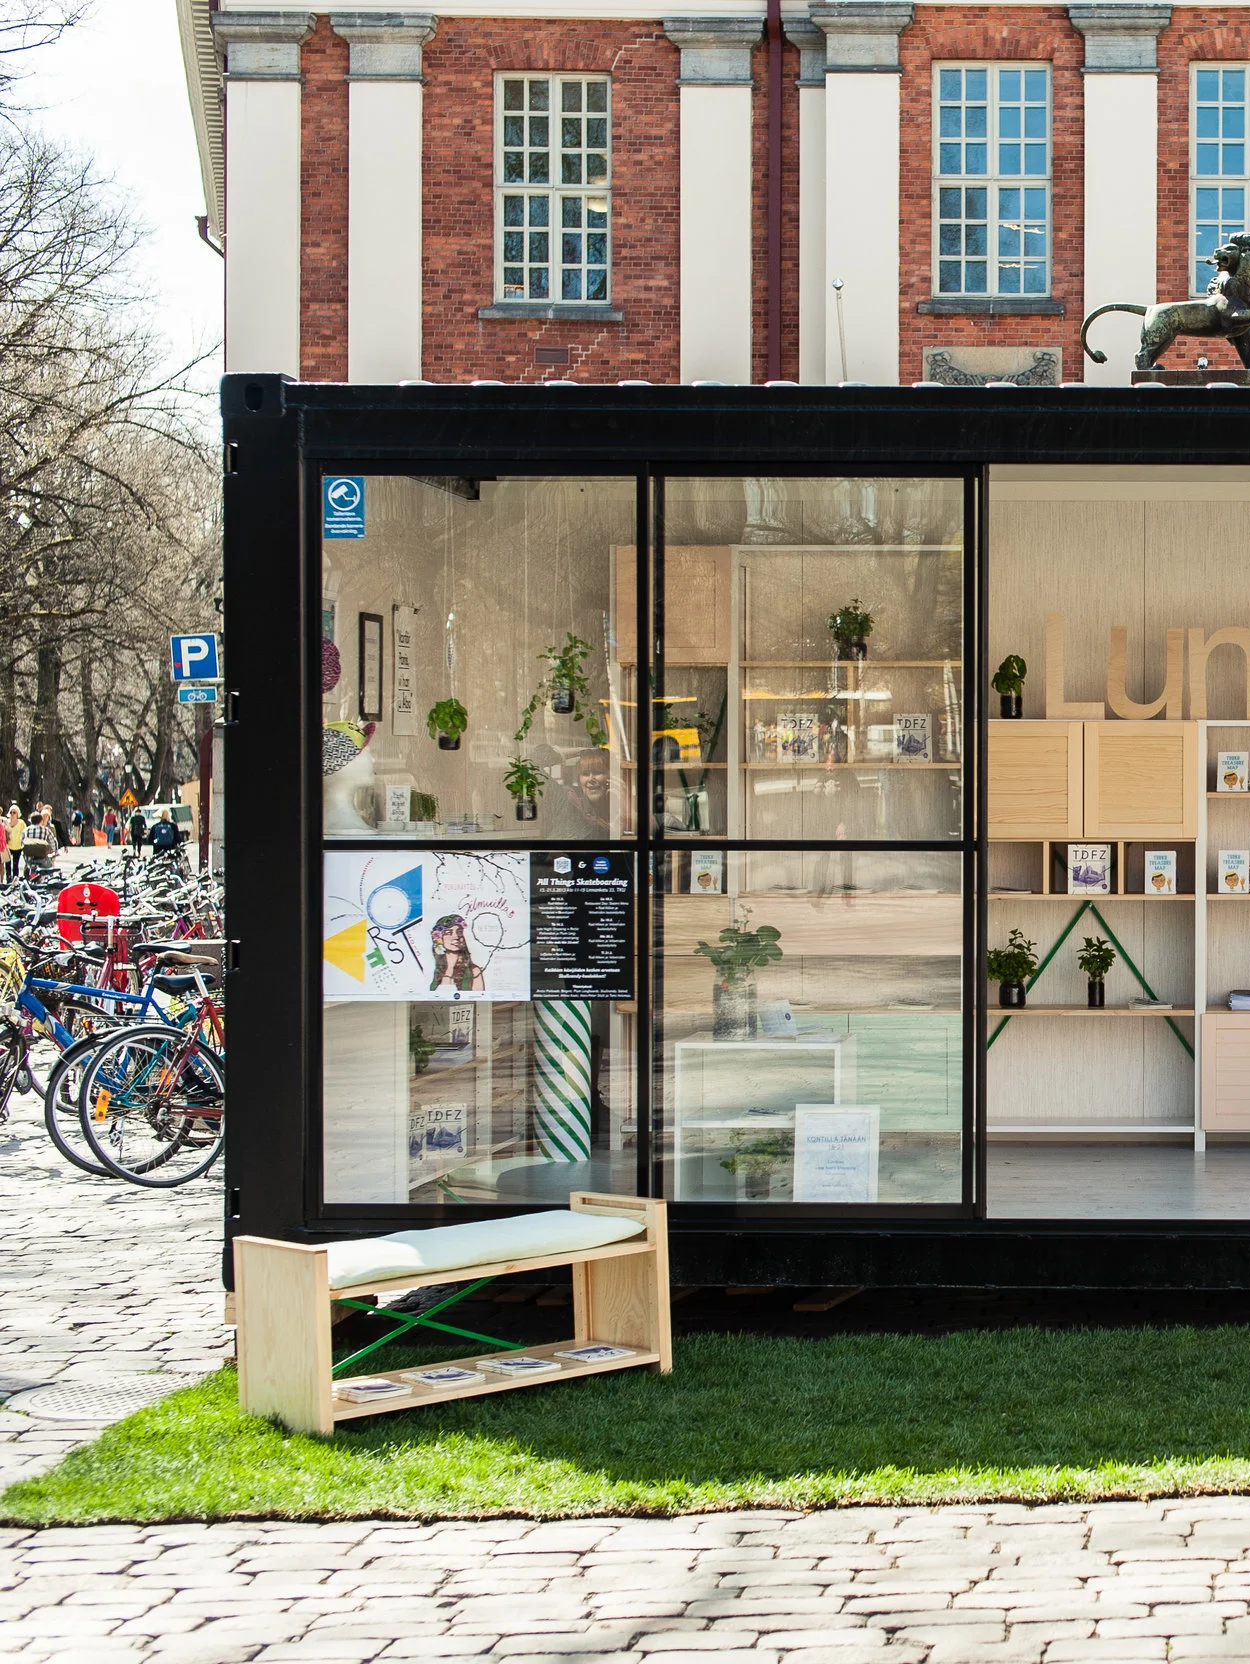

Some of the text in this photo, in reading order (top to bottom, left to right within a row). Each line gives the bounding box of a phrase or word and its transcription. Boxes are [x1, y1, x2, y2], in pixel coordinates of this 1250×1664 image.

[180, 638, 209, 677] P
[897, 719, 927, 729] TDFZ
[1072, 850, 1107, 860] TDFZ
[536, 878, 629, 887] All Things Skateboarding
[452, 1010, 471, 1022] TDFZ
[427, 1109, 463, 1122] TDFZ
[410, 1116, 426, 1129] DFZ
